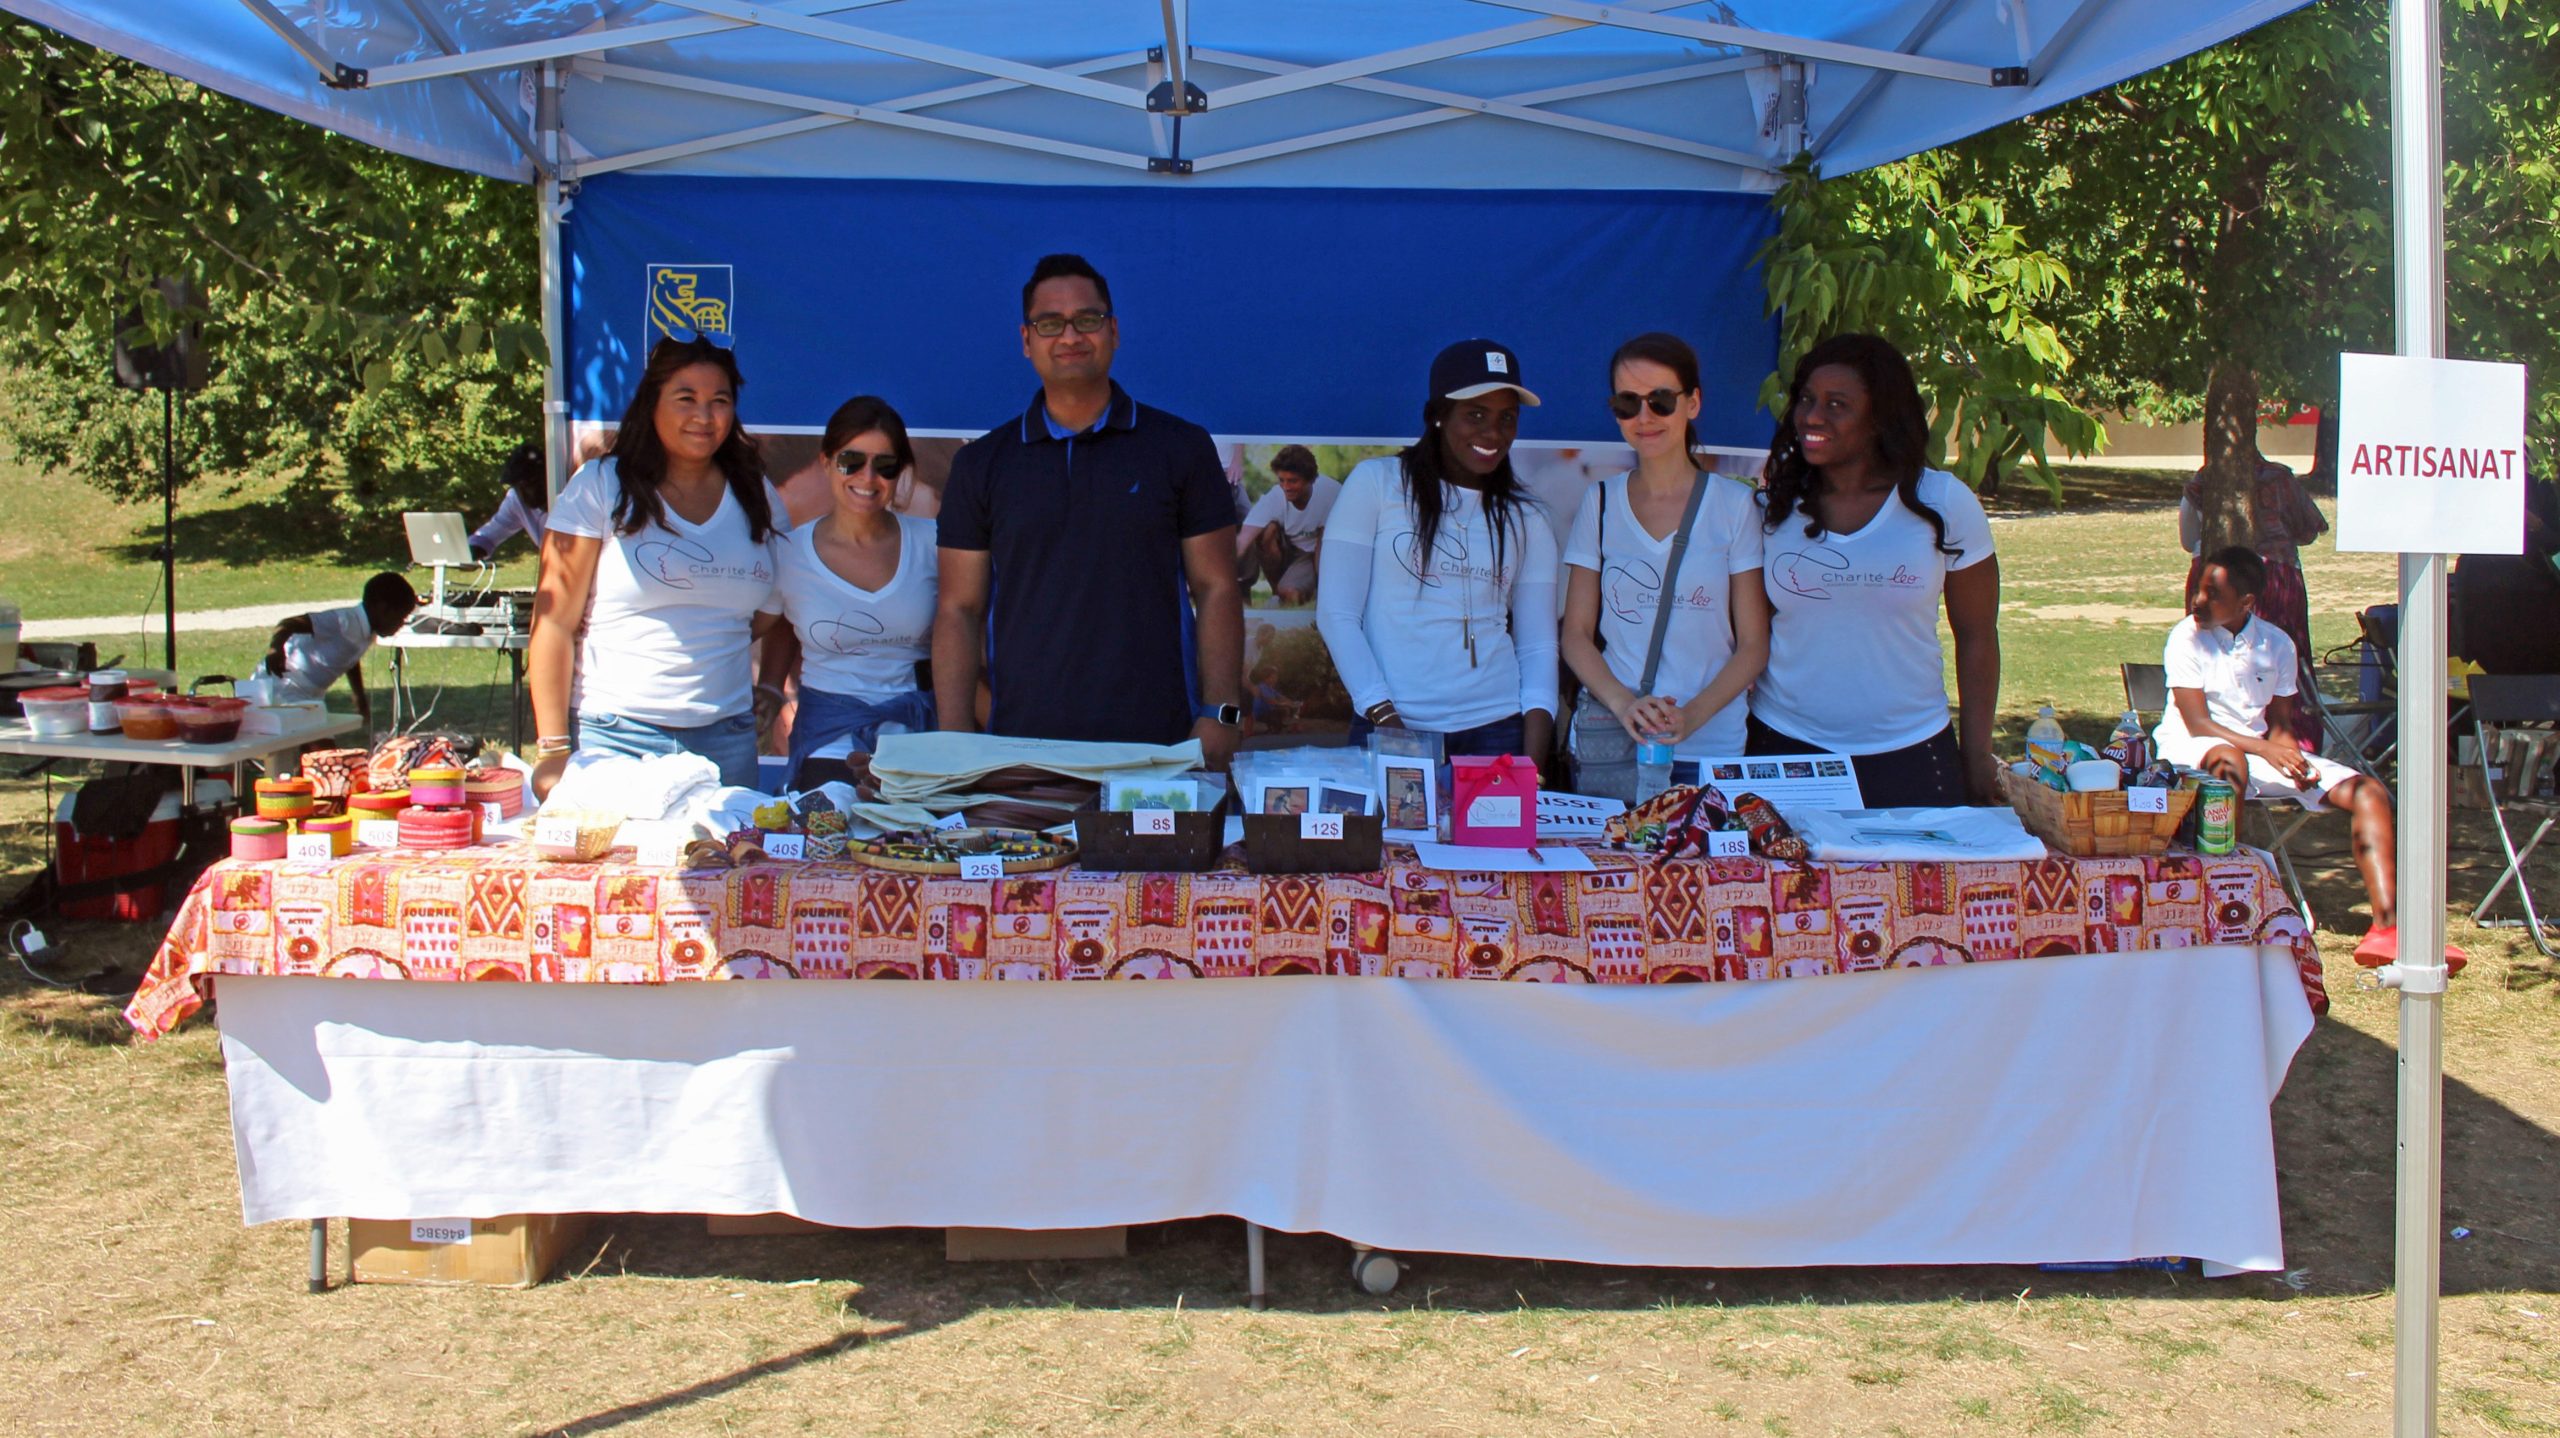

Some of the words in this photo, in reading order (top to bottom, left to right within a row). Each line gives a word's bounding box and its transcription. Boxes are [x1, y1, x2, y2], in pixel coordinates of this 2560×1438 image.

[2350, 443, 2517, 480] ARTISANAT
[1536, 796, 1603, 811] ISSE
[1152, 817, 1171, 832] 8$
[1311, 821, 1339, 838] 12$
[298, 844, 327, 857] 40$
[771, 843, 799, 858] 40$
[1719, 840, 1746, 855] 18$
[970, 863, 1000, 878] 25$
[1591, 874, 1627, 889] DAY
[1964, 888, 2017, 902] JOURNEE
[403, 907, 458, 918] JOURNEE
[793, 907, 850, 918] JOURNEE
[1196, 904, 1252, 916] JOURNEE
[1965, 903, 2017, 918] INTER
[406, 922, 459, 934] INTER
[796, 922, 850, 934] INTER
[1197, 919, 1252, 933] INTER
[1588, 919, 1641, 929] JOURNEE
[1966, 920, 2018, 935] NATIO
[1197, 936, 1253, 950] NATIO
[1590, 932, 1644, 943] INTER
[406, 940, 459, 952] NATIO
[795, 940, 850, 952] NATIO
[1971, 937, 2013, 953] NALE
[1592, 947, 1646, 960] NATIO
[411, 957, 454, 969] NALE
[801, 958, 844, 971] NALE
[1202, 954, 1247, 968] NALE
[1597, 964, 1640, 976] NALE
